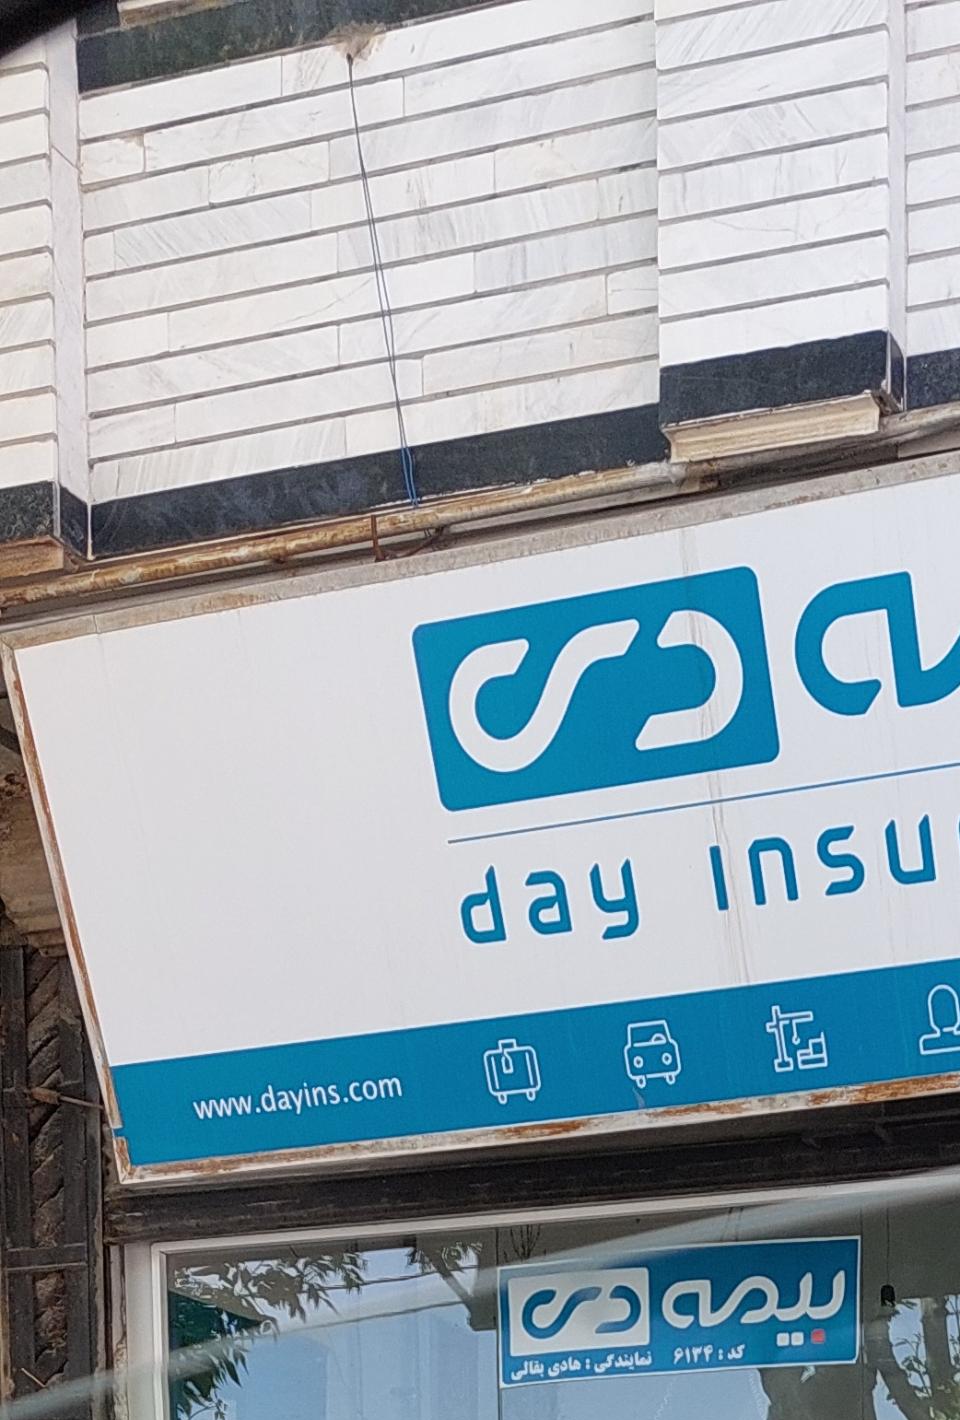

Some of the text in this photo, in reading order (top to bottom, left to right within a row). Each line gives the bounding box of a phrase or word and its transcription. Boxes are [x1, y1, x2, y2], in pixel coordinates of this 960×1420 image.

[445, 606, 743, 772] دی
[461, 859, 639, 943] day
[193, 1071, 402, 1122] www.dayins.com
[522, 1271, 845, 1346] بیمه دی
[548, 1357, 581, 1377] هادی
[674, 1345, 713, 1364] ۶۱۳۴
[728, 1345, 744, 1359] کد
[511, 1361, 544, 1380] بقالی
